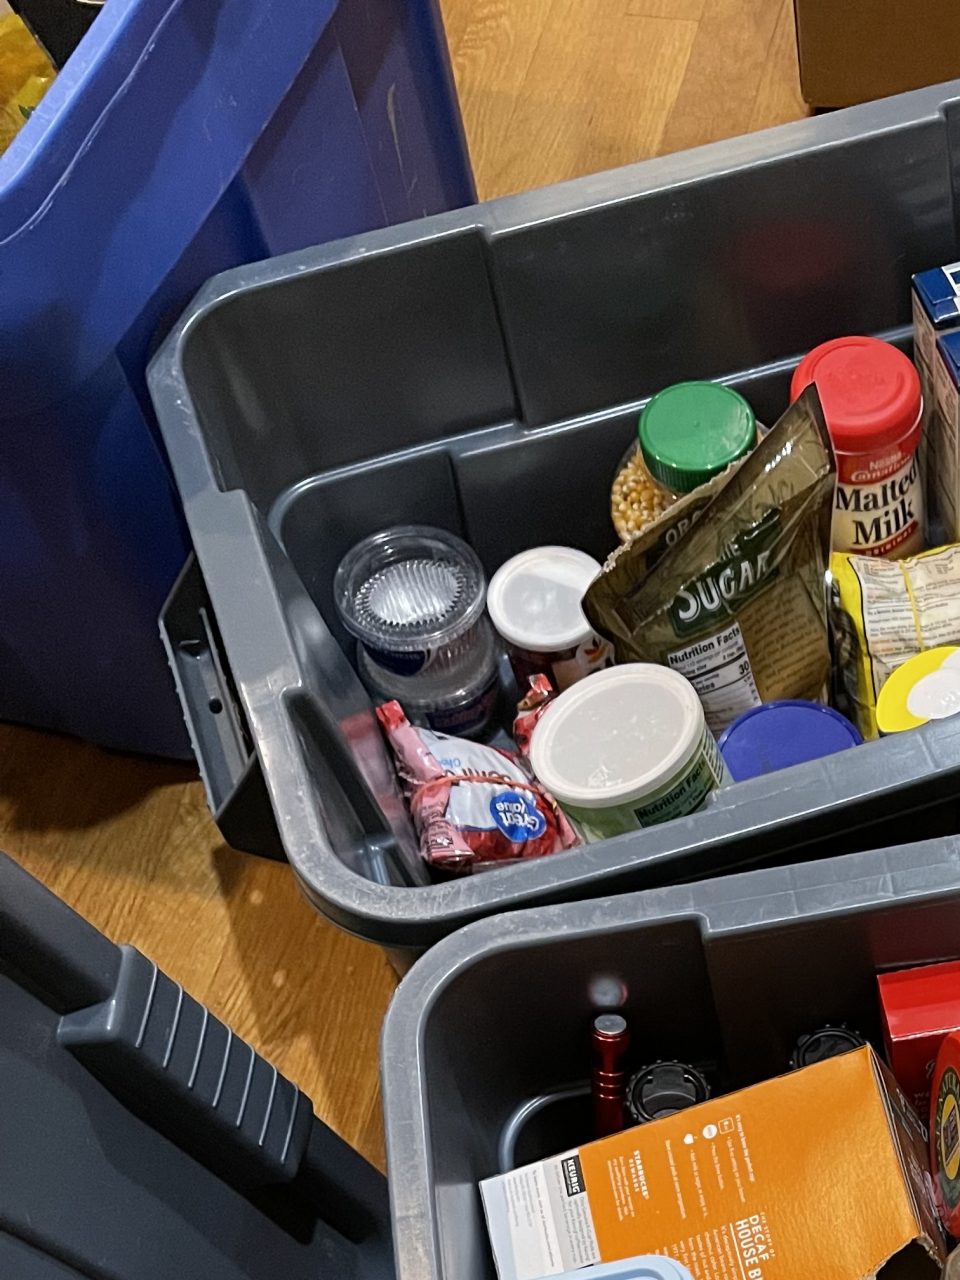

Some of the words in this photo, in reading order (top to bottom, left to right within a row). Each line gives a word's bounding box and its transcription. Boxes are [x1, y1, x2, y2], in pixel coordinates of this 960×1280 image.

[835, 451, 919, 512] Malted
[852, 499, 914, 545] Milk
[675, 551, 771, 621] SUGAR
[669, 641, 715, 666] Nutrition
[716, 624, 741, 650] Facts
[738, 660, 750, 676] 30
[495, 797, 526, 816] Value
[499, 811, 540, 831] Great
[638, 779, 687, 821] Nutrition
[567, 1159, 580, 1193] KEURIG
[633, 1150, 649, 1200] STARBUCKS
[735, 1218, 759, 1267] HOUSE
[749, 1214, 770, 1262] DECAF
